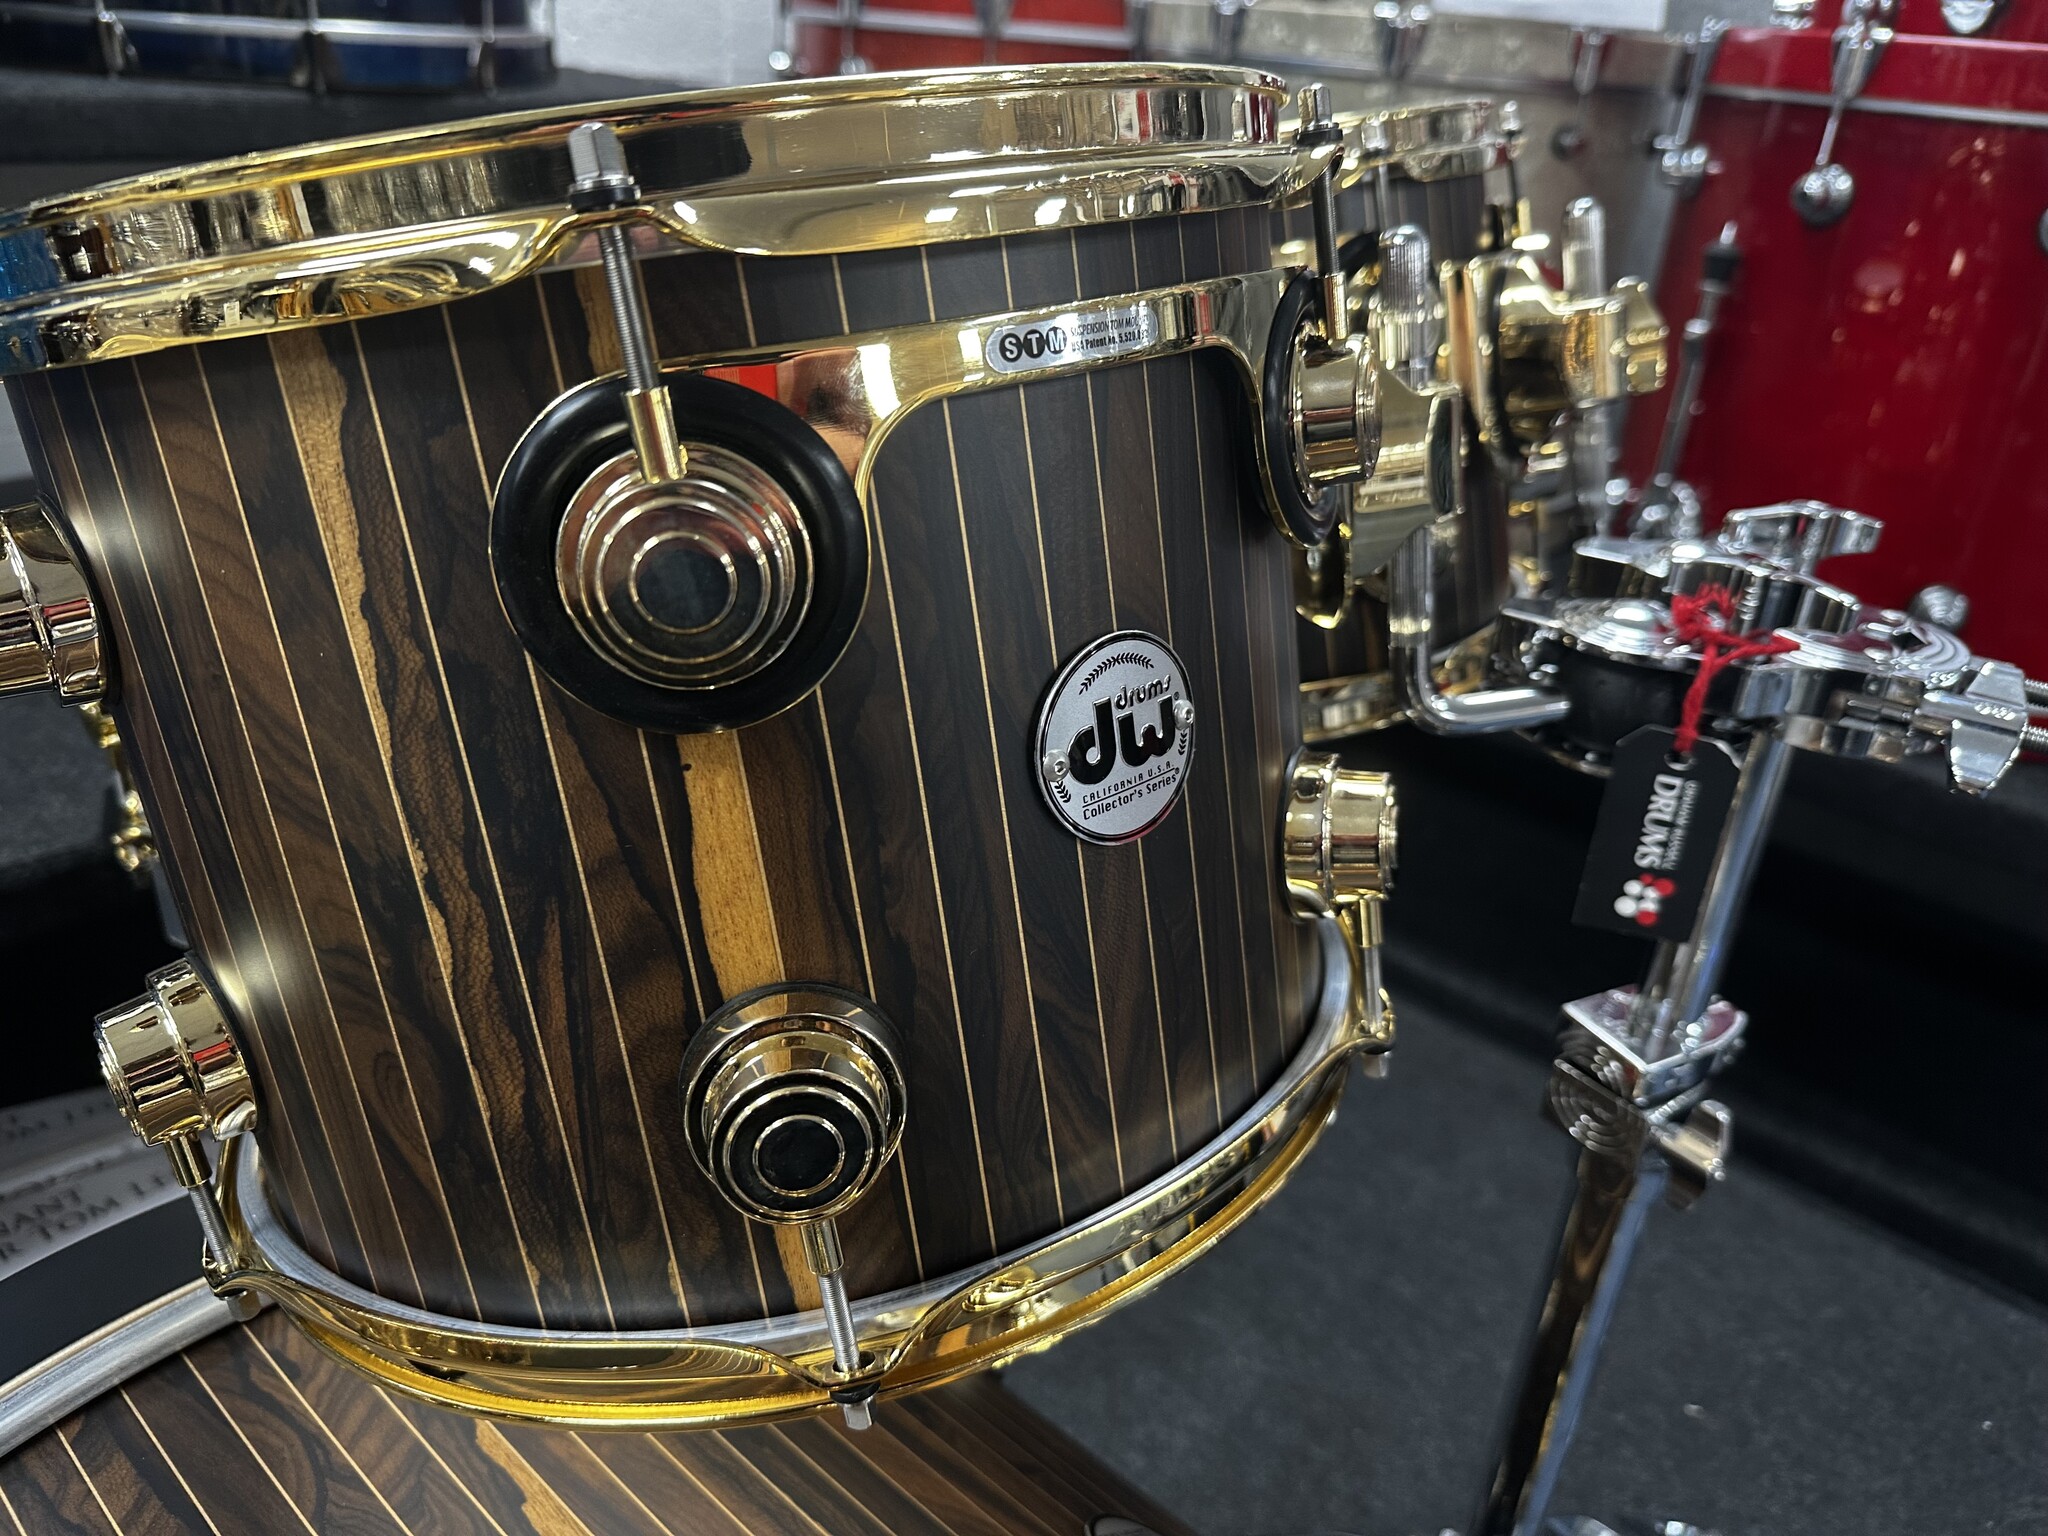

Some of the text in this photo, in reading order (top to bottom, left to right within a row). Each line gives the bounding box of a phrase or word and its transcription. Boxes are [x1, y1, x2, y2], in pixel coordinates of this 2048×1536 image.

[1003, 327, 1065, 360] STM
[1071, 320, 1109, 336] SUSPENSION
[1110, 319, 1124, 330] TOM
[1085, 337, 1107, 349] Patent
[1115, 674, 1171, 710] drums
[1068, 695, 1176, 785] dw
[1082, 760, 1175, 804] CALIFORNIA U.S.A.
[1083, 788, 1143, 821] Collector's
[1634, 774, 1683, 869] DRUMS
